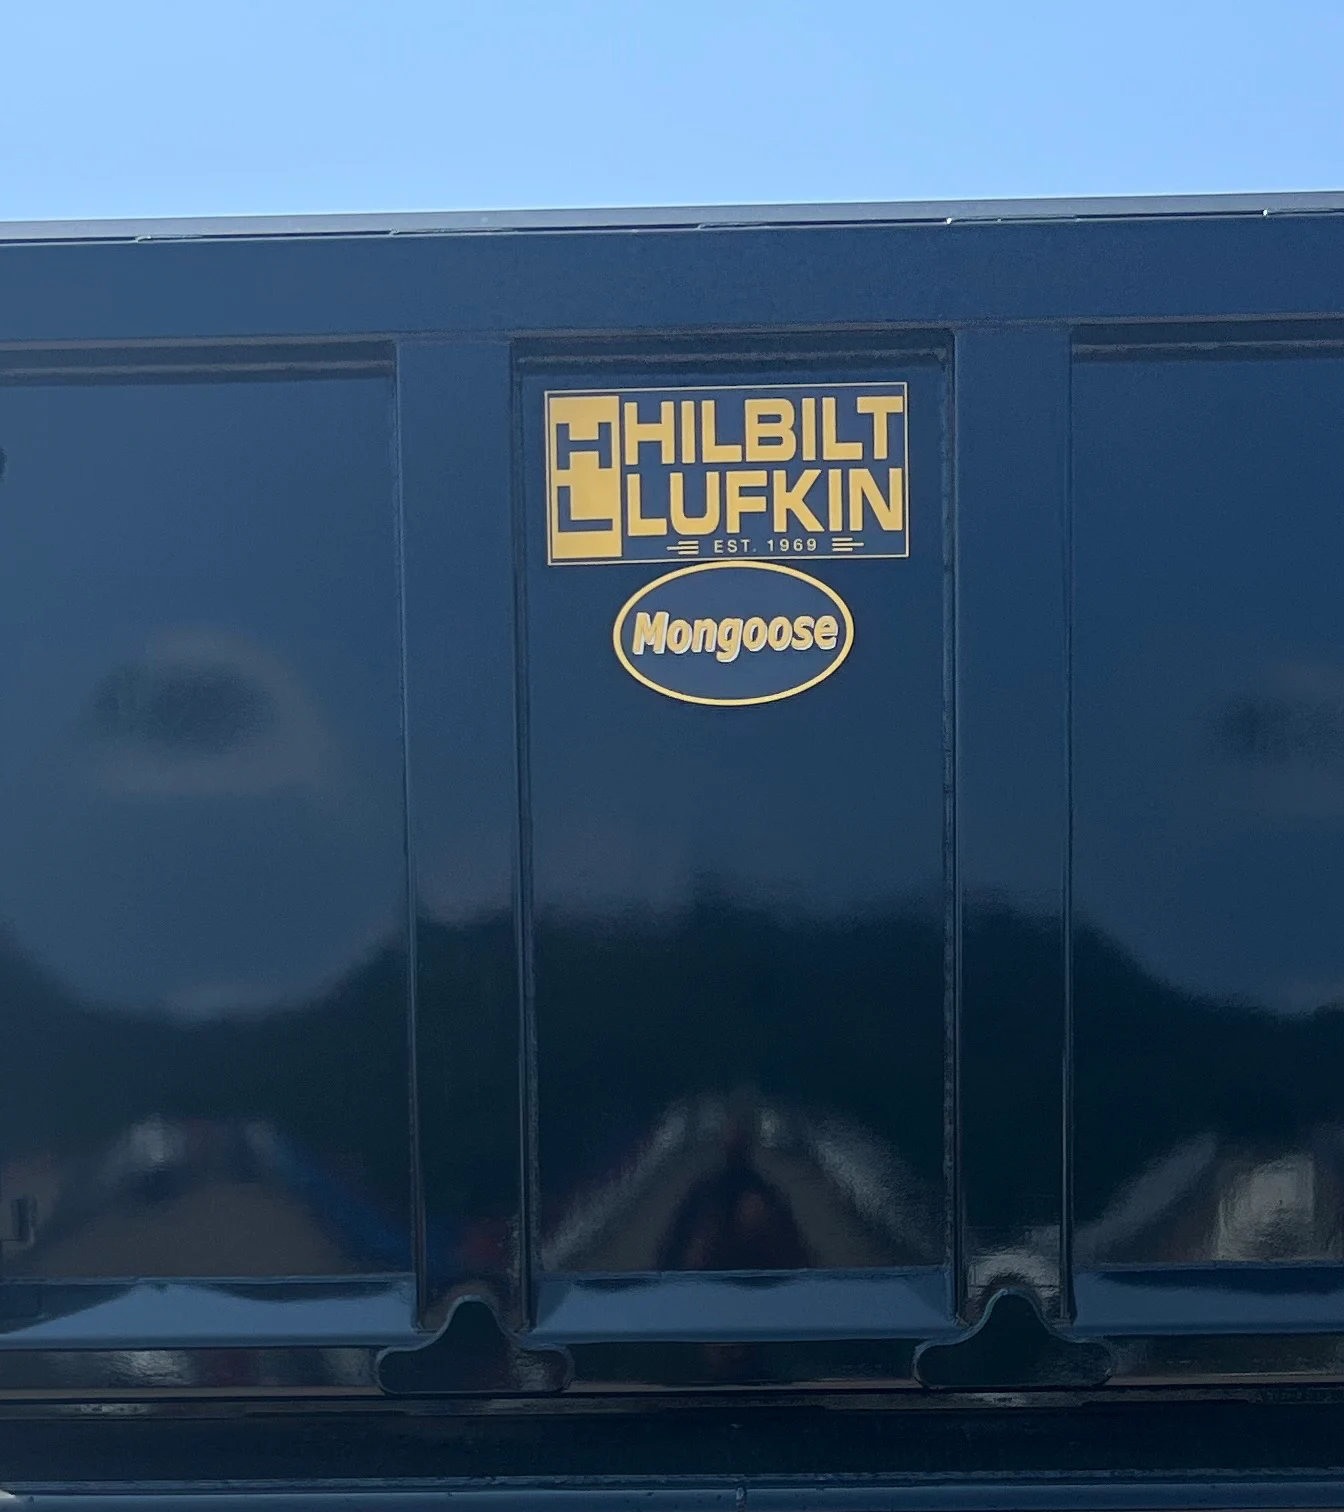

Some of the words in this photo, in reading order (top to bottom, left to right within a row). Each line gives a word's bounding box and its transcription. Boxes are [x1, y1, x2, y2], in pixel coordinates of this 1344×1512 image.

[624, 395, 905, 466] HILBILT
[626, 467, 904, 537] LUFKIN
[768, 538, 818, 553] 1969
[632, 611, 839, 663] Mongoose
